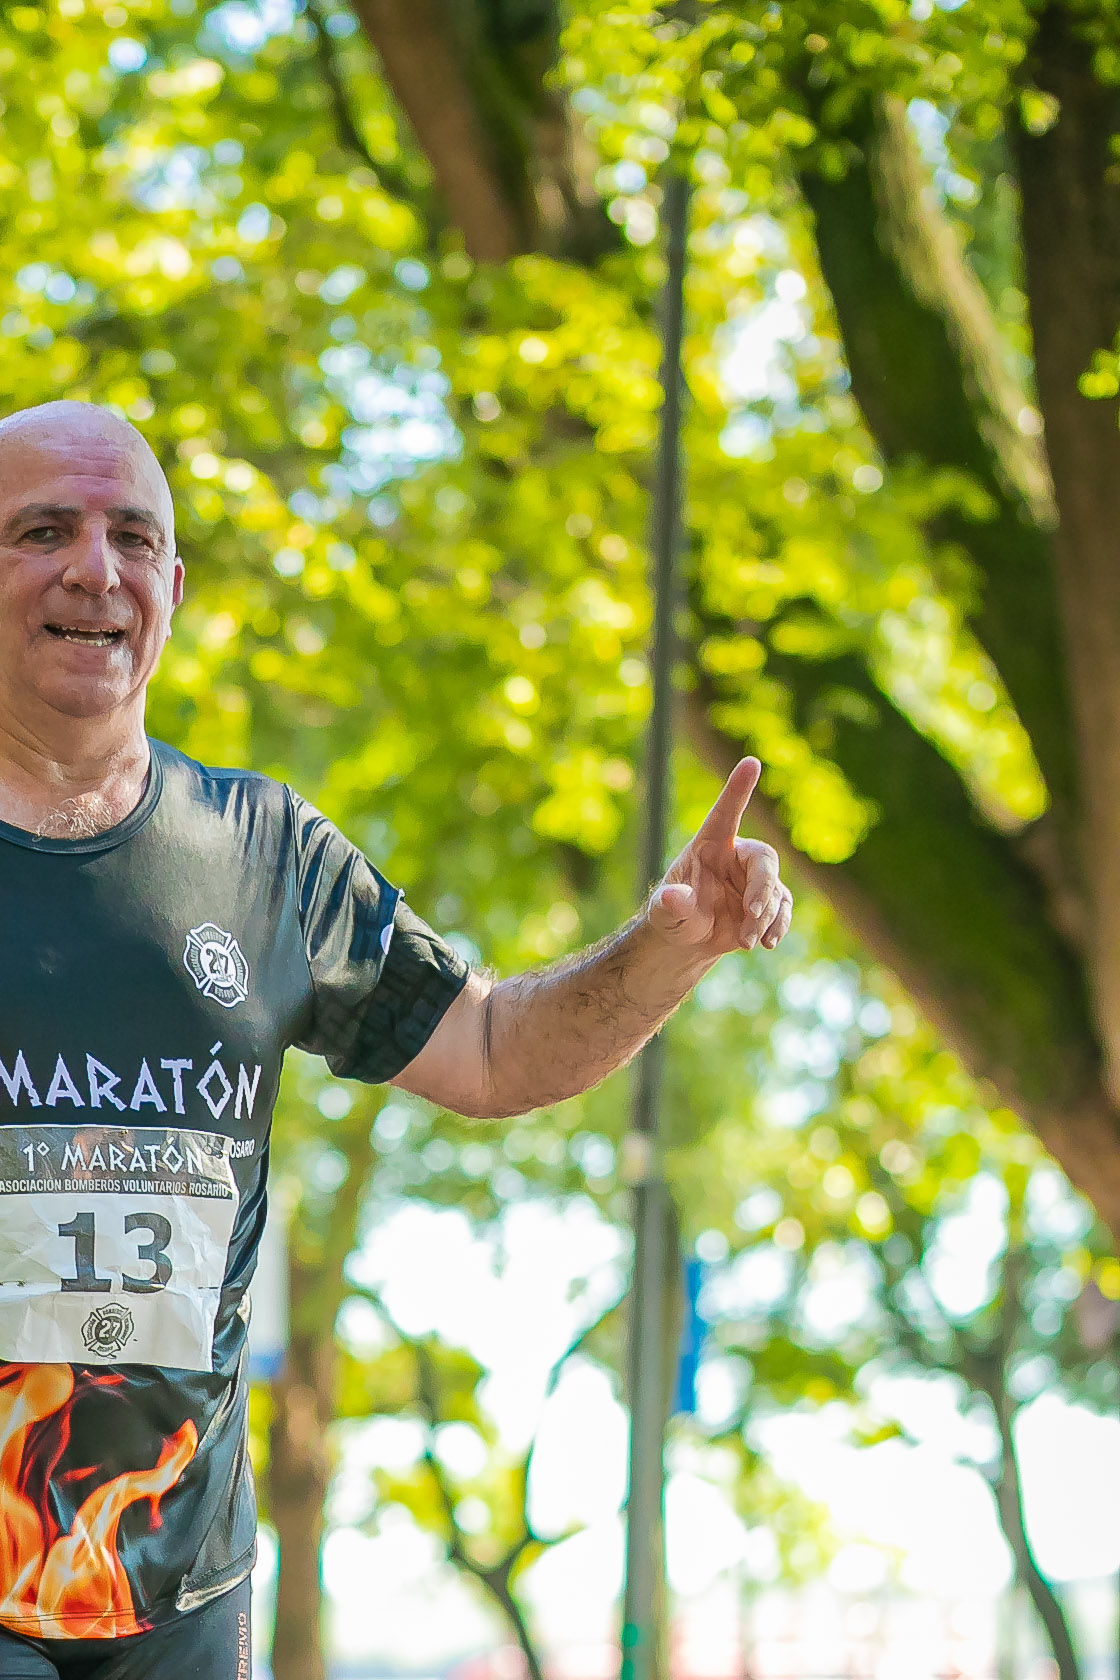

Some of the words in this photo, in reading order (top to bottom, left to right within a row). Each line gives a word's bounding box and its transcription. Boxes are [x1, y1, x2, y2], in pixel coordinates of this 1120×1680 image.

[61, 1137, 204, 1175] MARATÓN
[64, 1178, 120, 1192] BOMBEROS
[122, 1179, 187, 1194] VOLUNTARIOS
[58, 1212, 173, 1294] 13
[99, 1319, 121, 1338] 27
